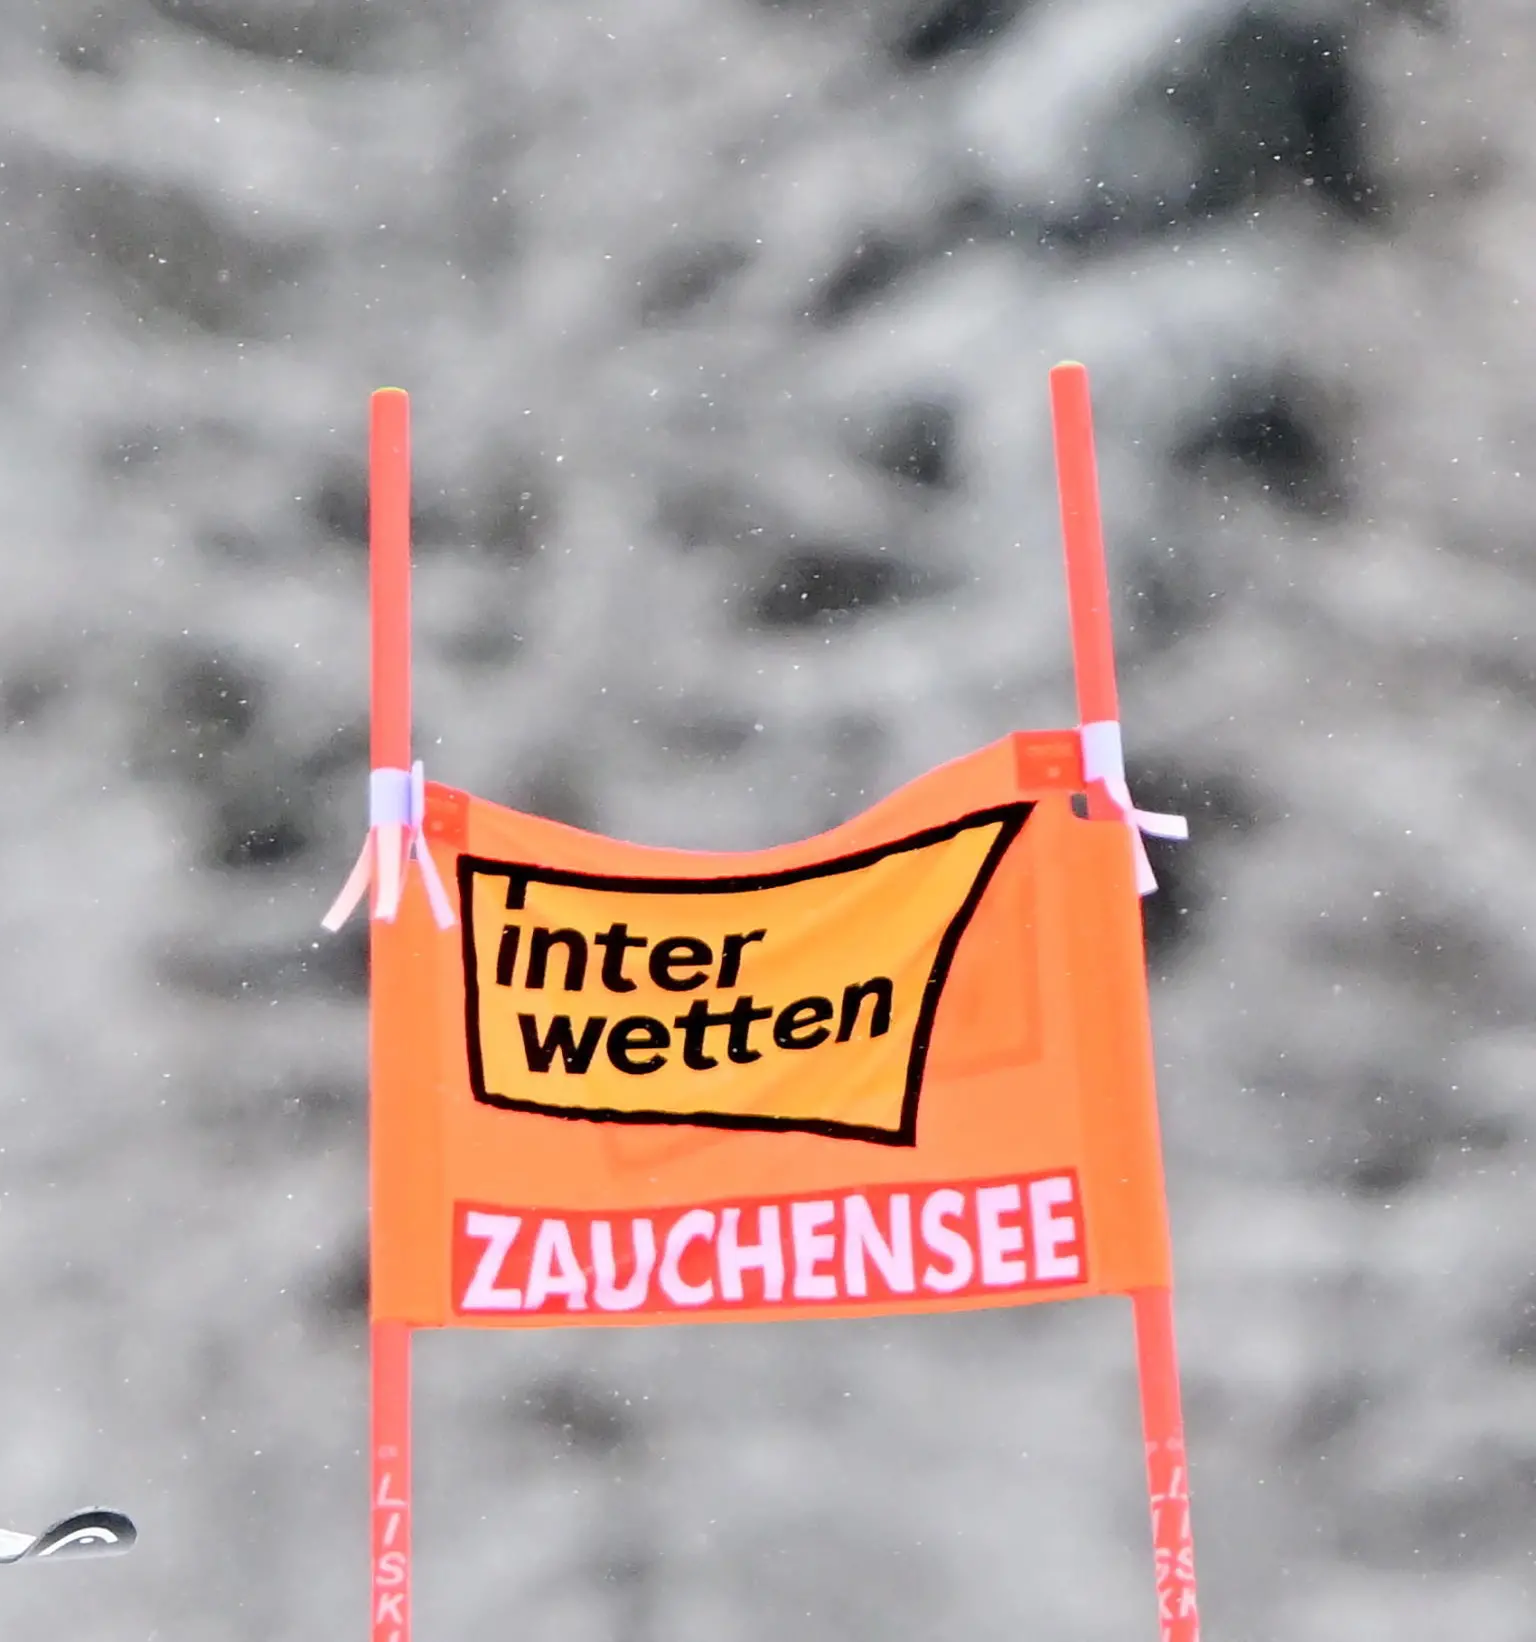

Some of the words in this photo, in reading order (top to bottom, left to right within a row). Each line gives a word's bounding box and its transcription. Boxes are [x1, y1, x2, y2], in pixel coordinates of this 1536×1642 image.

[495, 882, 767, 993] inter
[517, 973, 894, 1075] wetten
[462, 1176, 1080, 1311] ZAUCHENSEE
